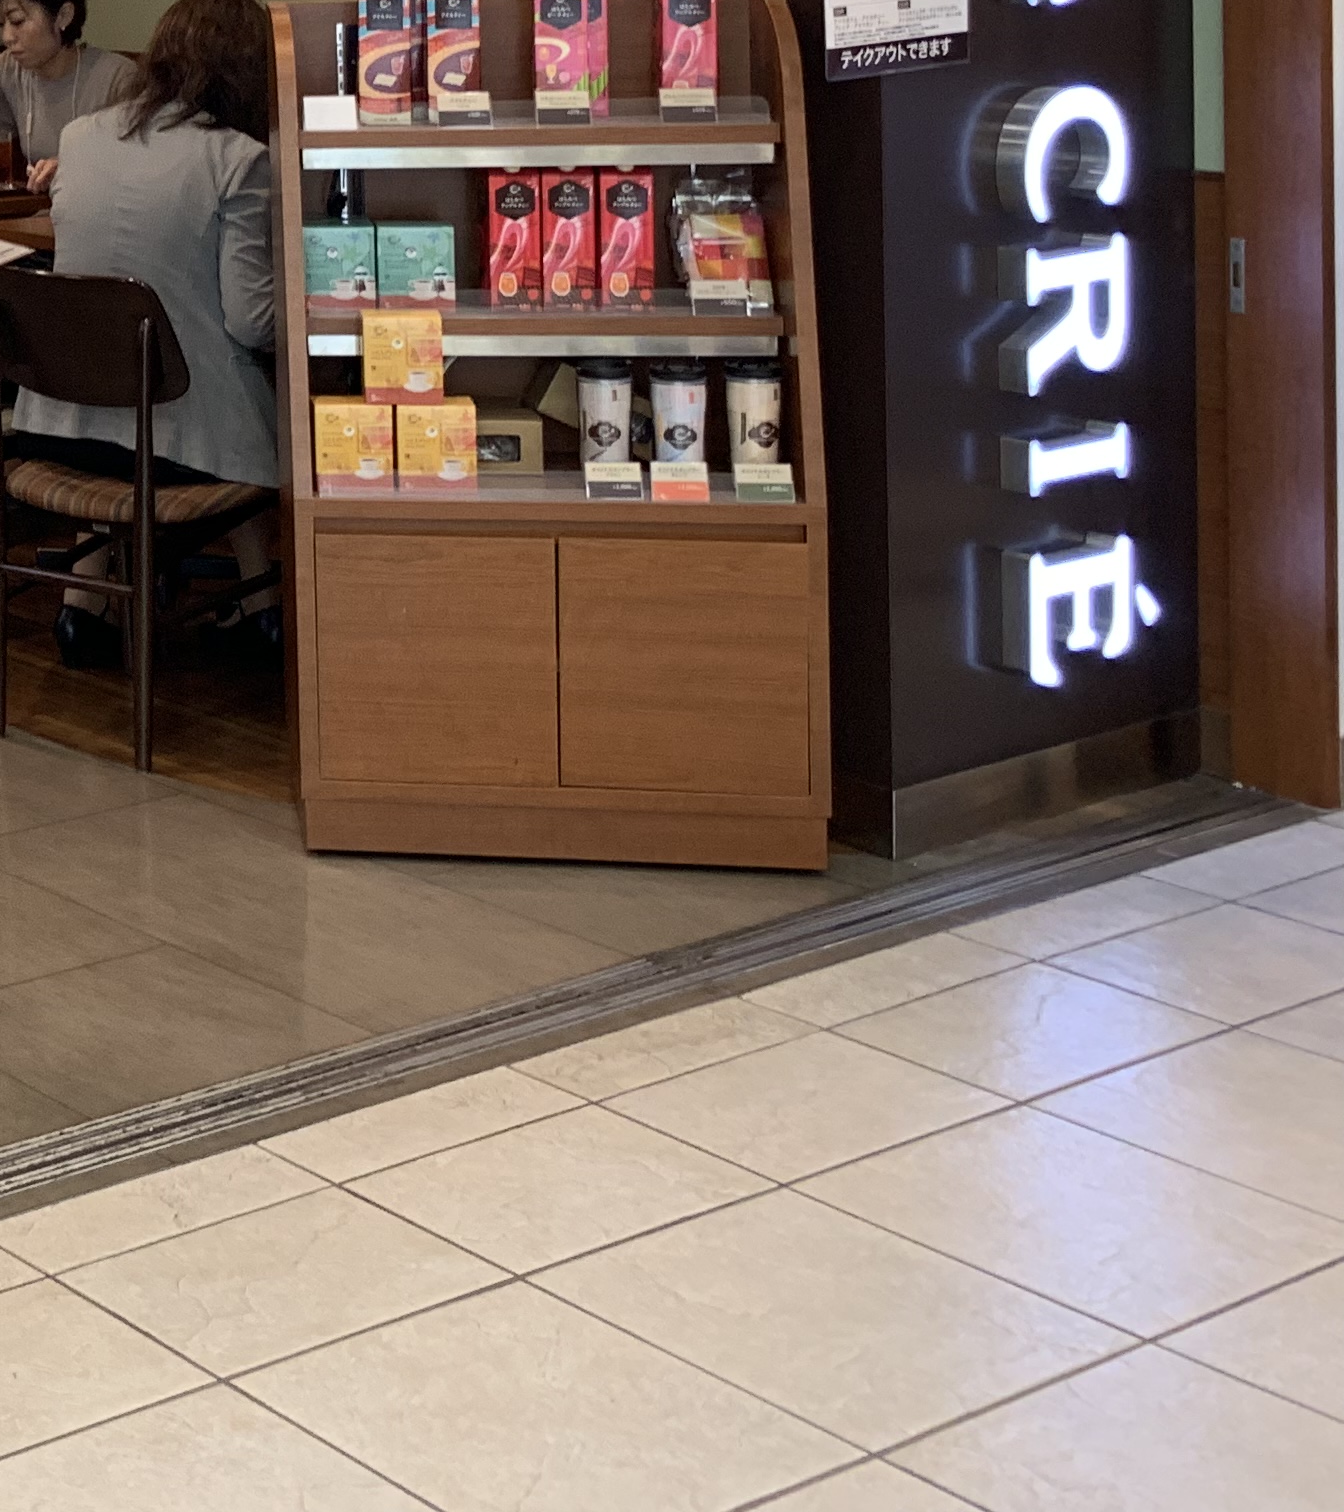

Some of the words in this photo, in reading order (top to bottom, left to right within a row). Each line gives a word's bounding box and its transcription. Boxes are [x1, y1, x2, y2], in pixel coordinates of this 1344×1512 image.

[840, 37, 952, 69] テイクアウトできます
[1023, 83, 1163, 687] CRIÉ
